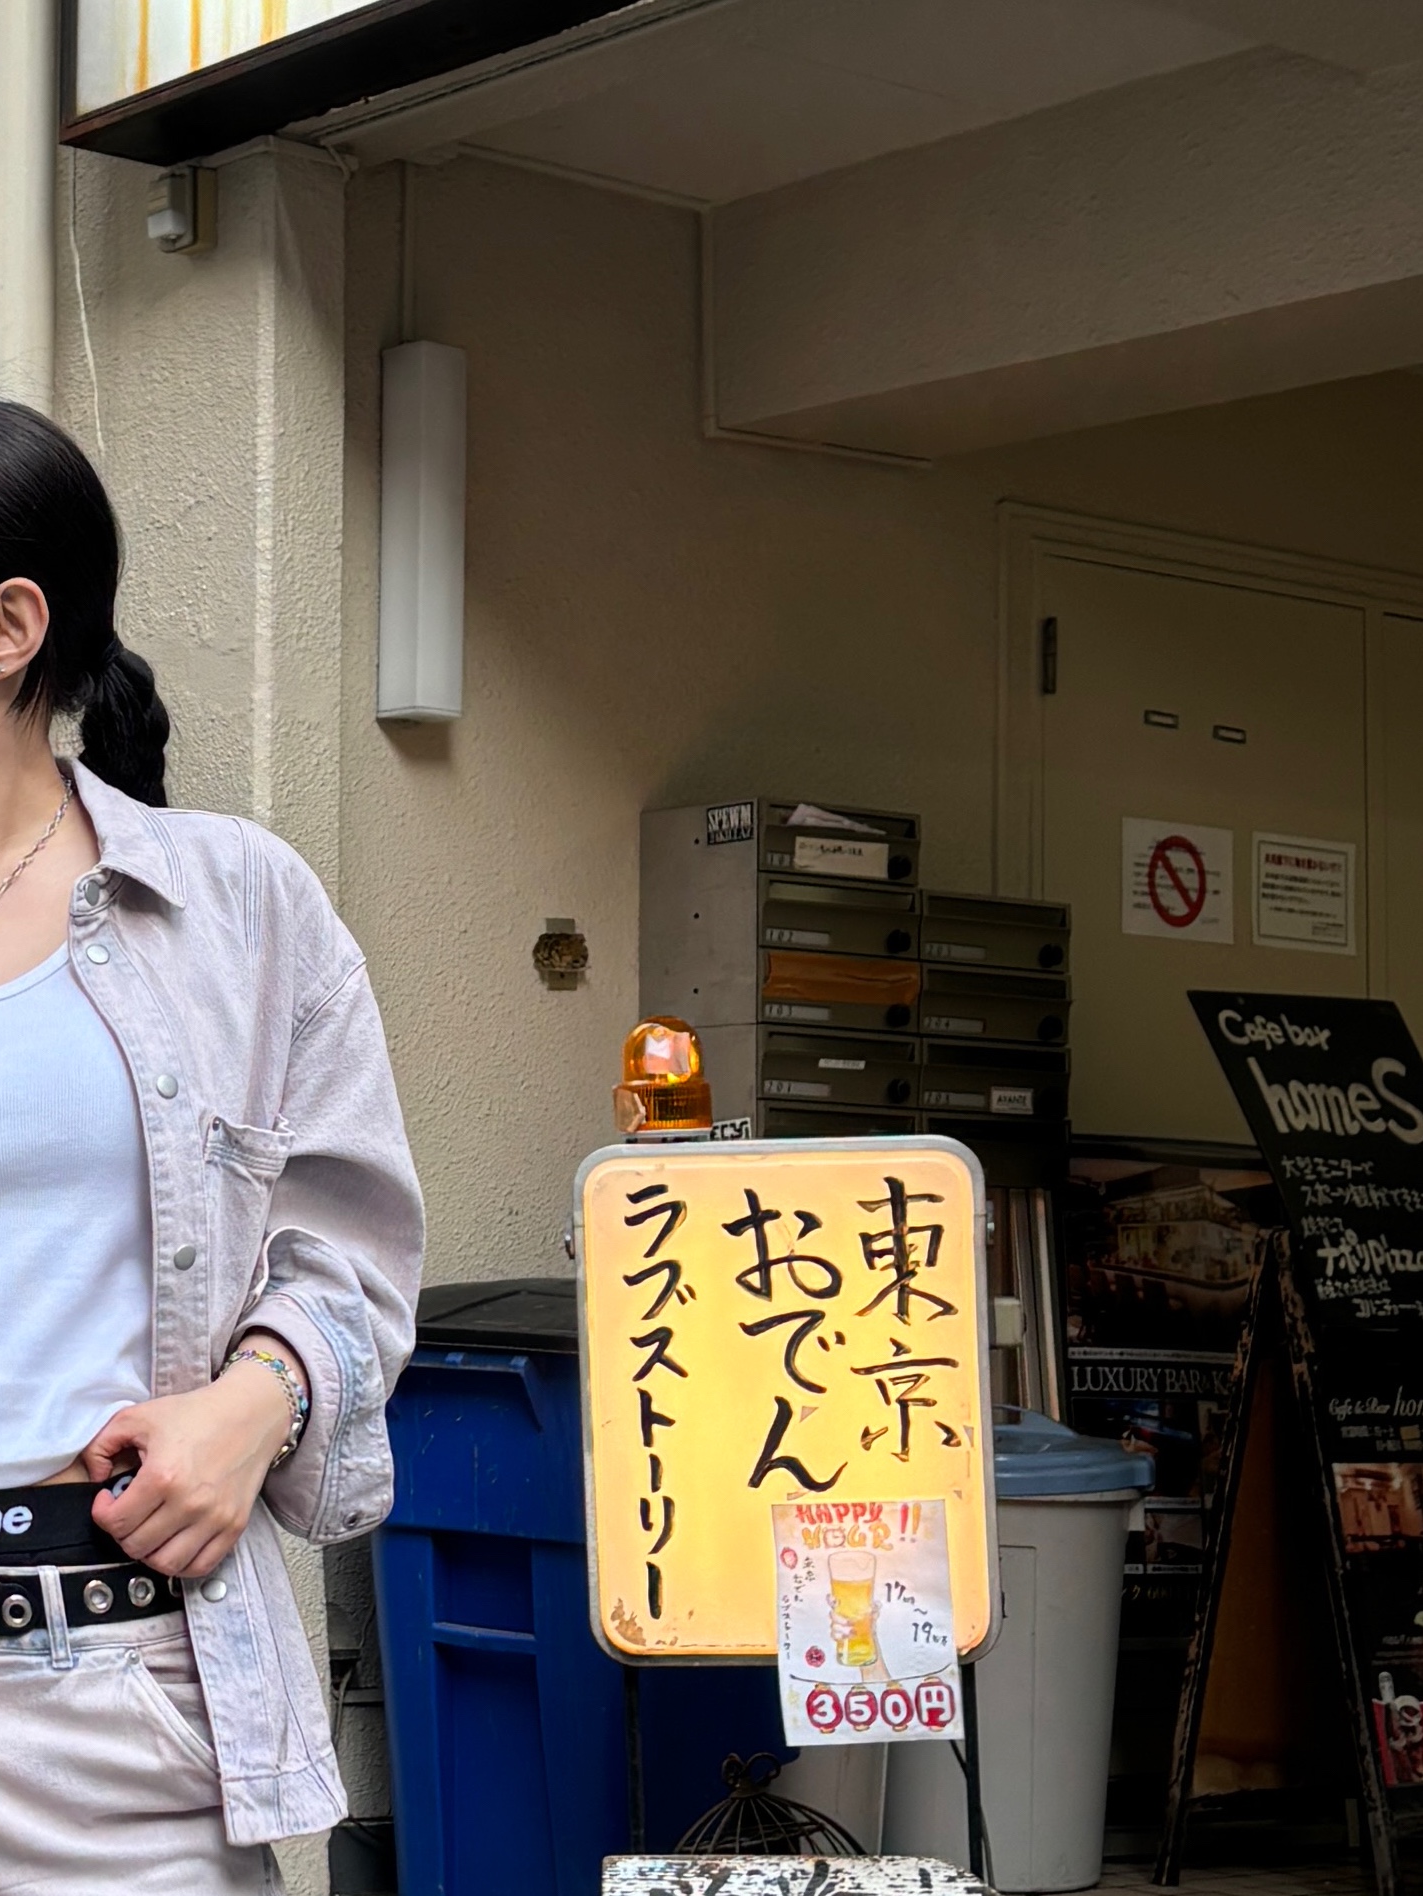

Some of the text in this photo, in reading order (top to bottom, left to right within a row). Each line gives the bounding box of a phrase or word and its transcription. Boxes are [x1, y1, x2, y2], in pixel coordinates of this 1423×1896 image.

[622, 1183, 696, 1620] ラブストーリー
[722, 1186, 849, 1493] おでん
[850, 1176, 965, 1463] 東京
[1070, 1366, 1161, 1393] LUXURY
[1164, 1368, 1203, 1394] BAR
[796, 1501, 884, 1525] HAPPY
